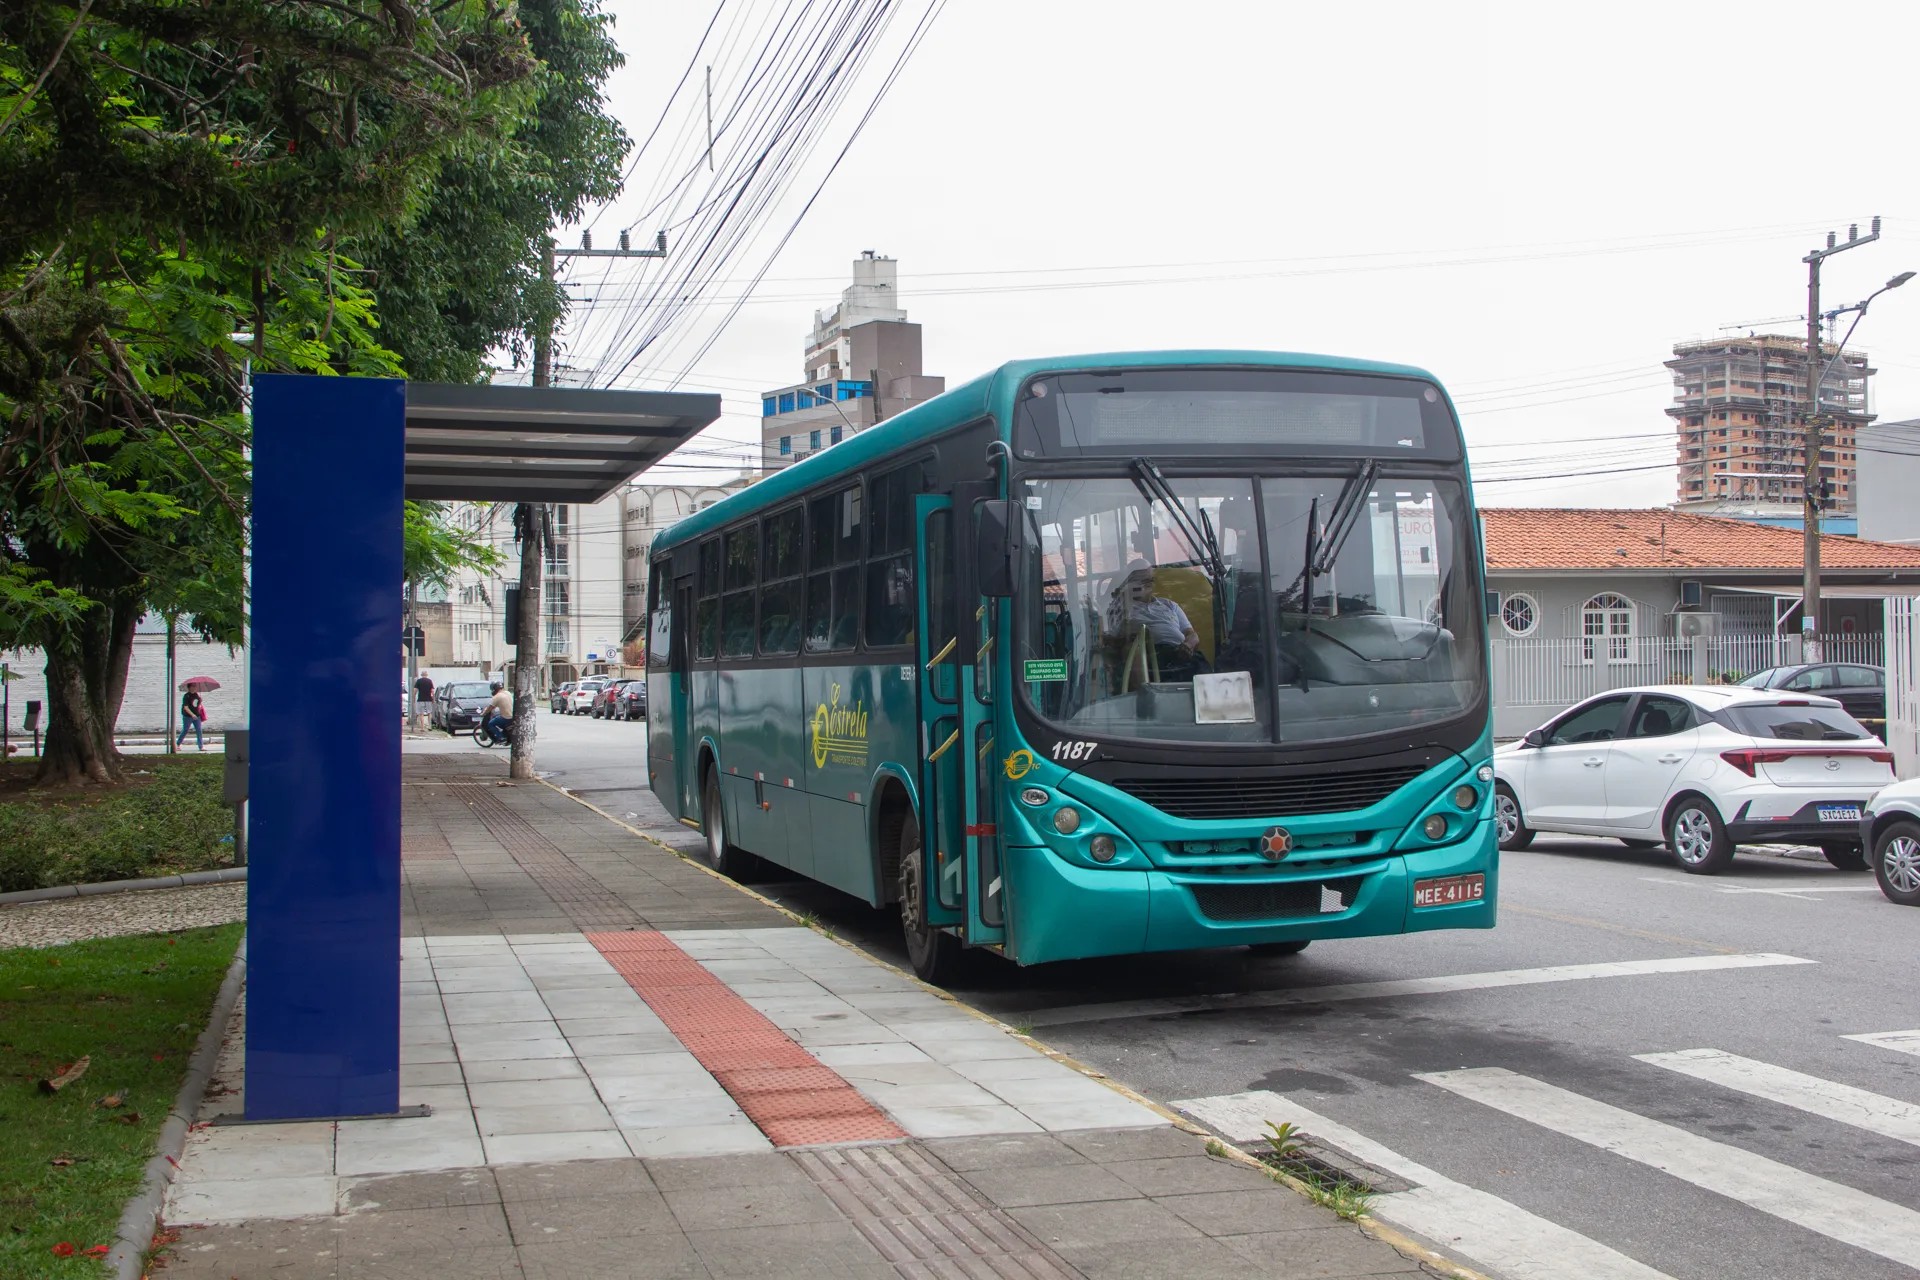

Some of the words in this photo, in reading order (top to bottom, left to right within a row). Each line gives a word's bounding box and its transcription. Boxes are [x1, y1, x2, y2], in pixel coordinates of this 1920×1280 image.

[830, 682, 867, 738] Estrela
[1052, 741, 1097, 760] 1187
[1822, 810, 1857, 820] SXC1E12
